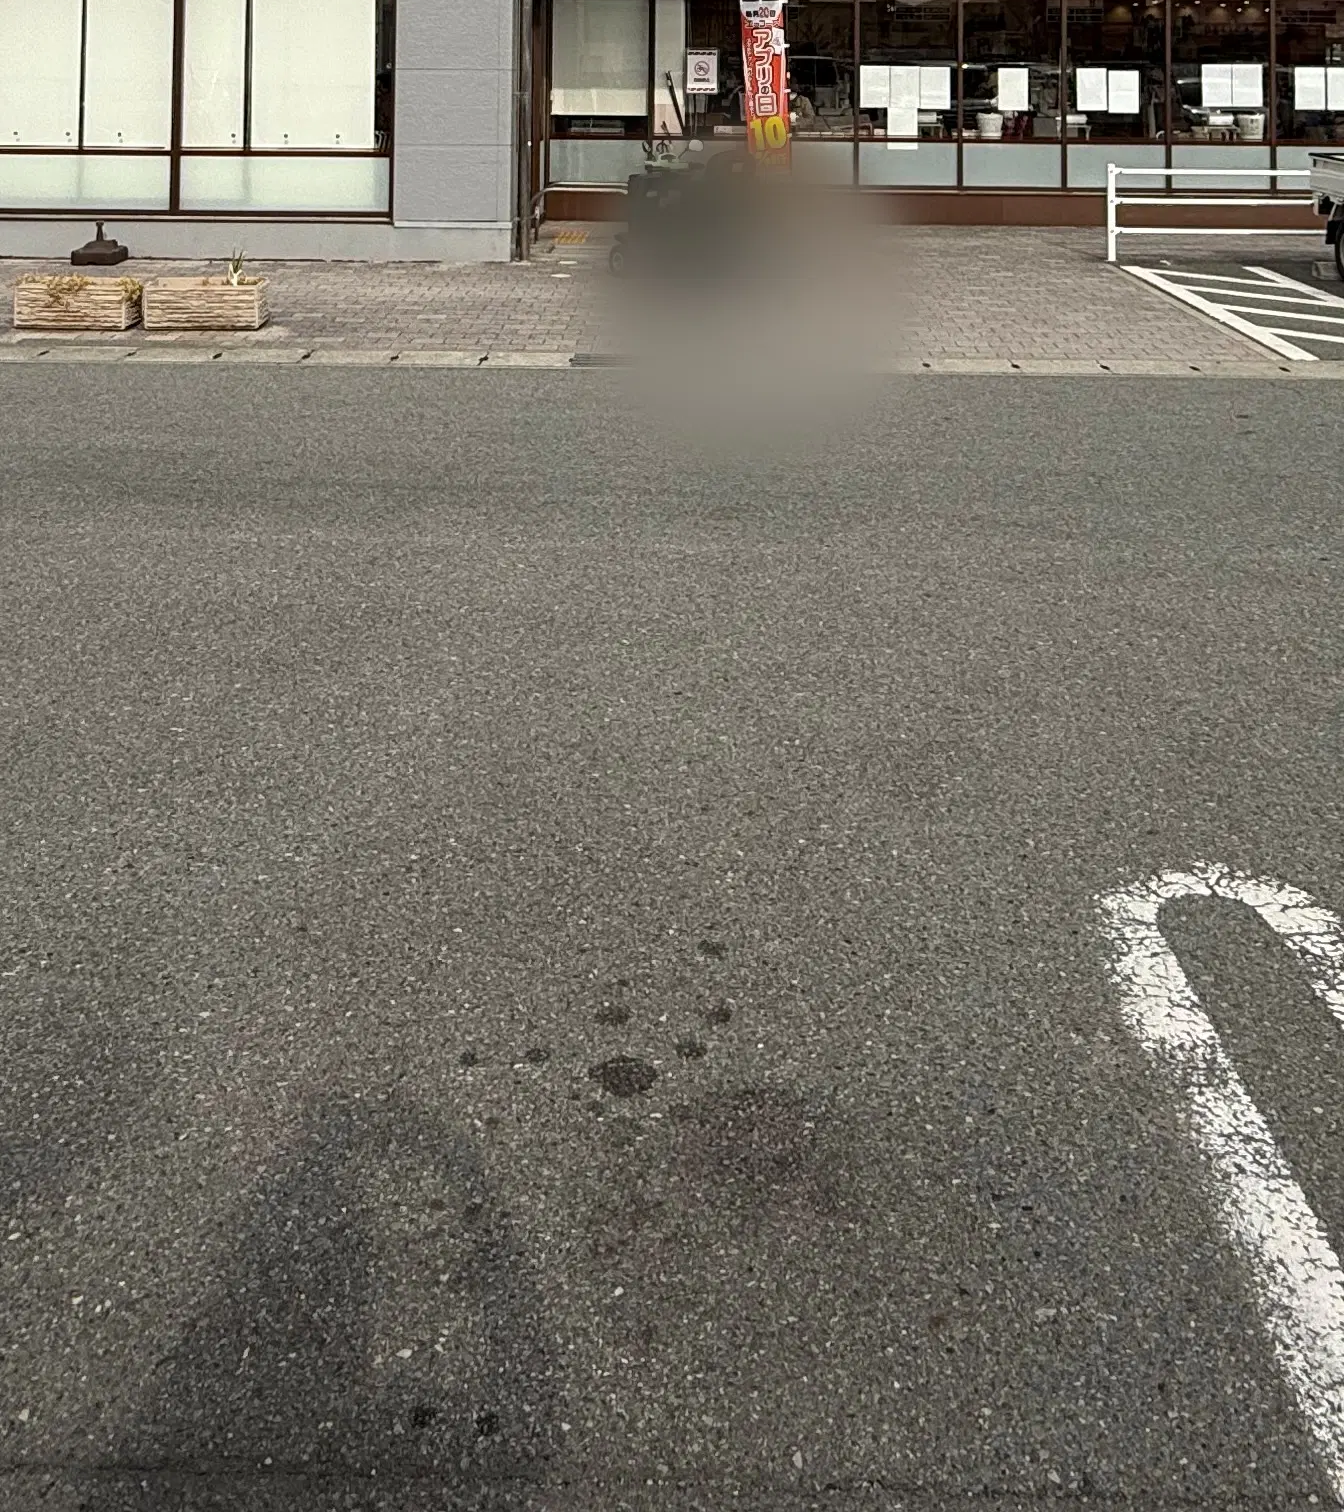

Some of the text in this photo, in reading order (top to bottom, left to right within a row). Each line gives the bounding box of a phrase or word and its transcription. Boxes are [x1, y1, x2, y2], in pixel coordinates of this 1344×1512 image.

[752, 28, 778, 116] アプリの日
[749, 116, 787, 150] 10
